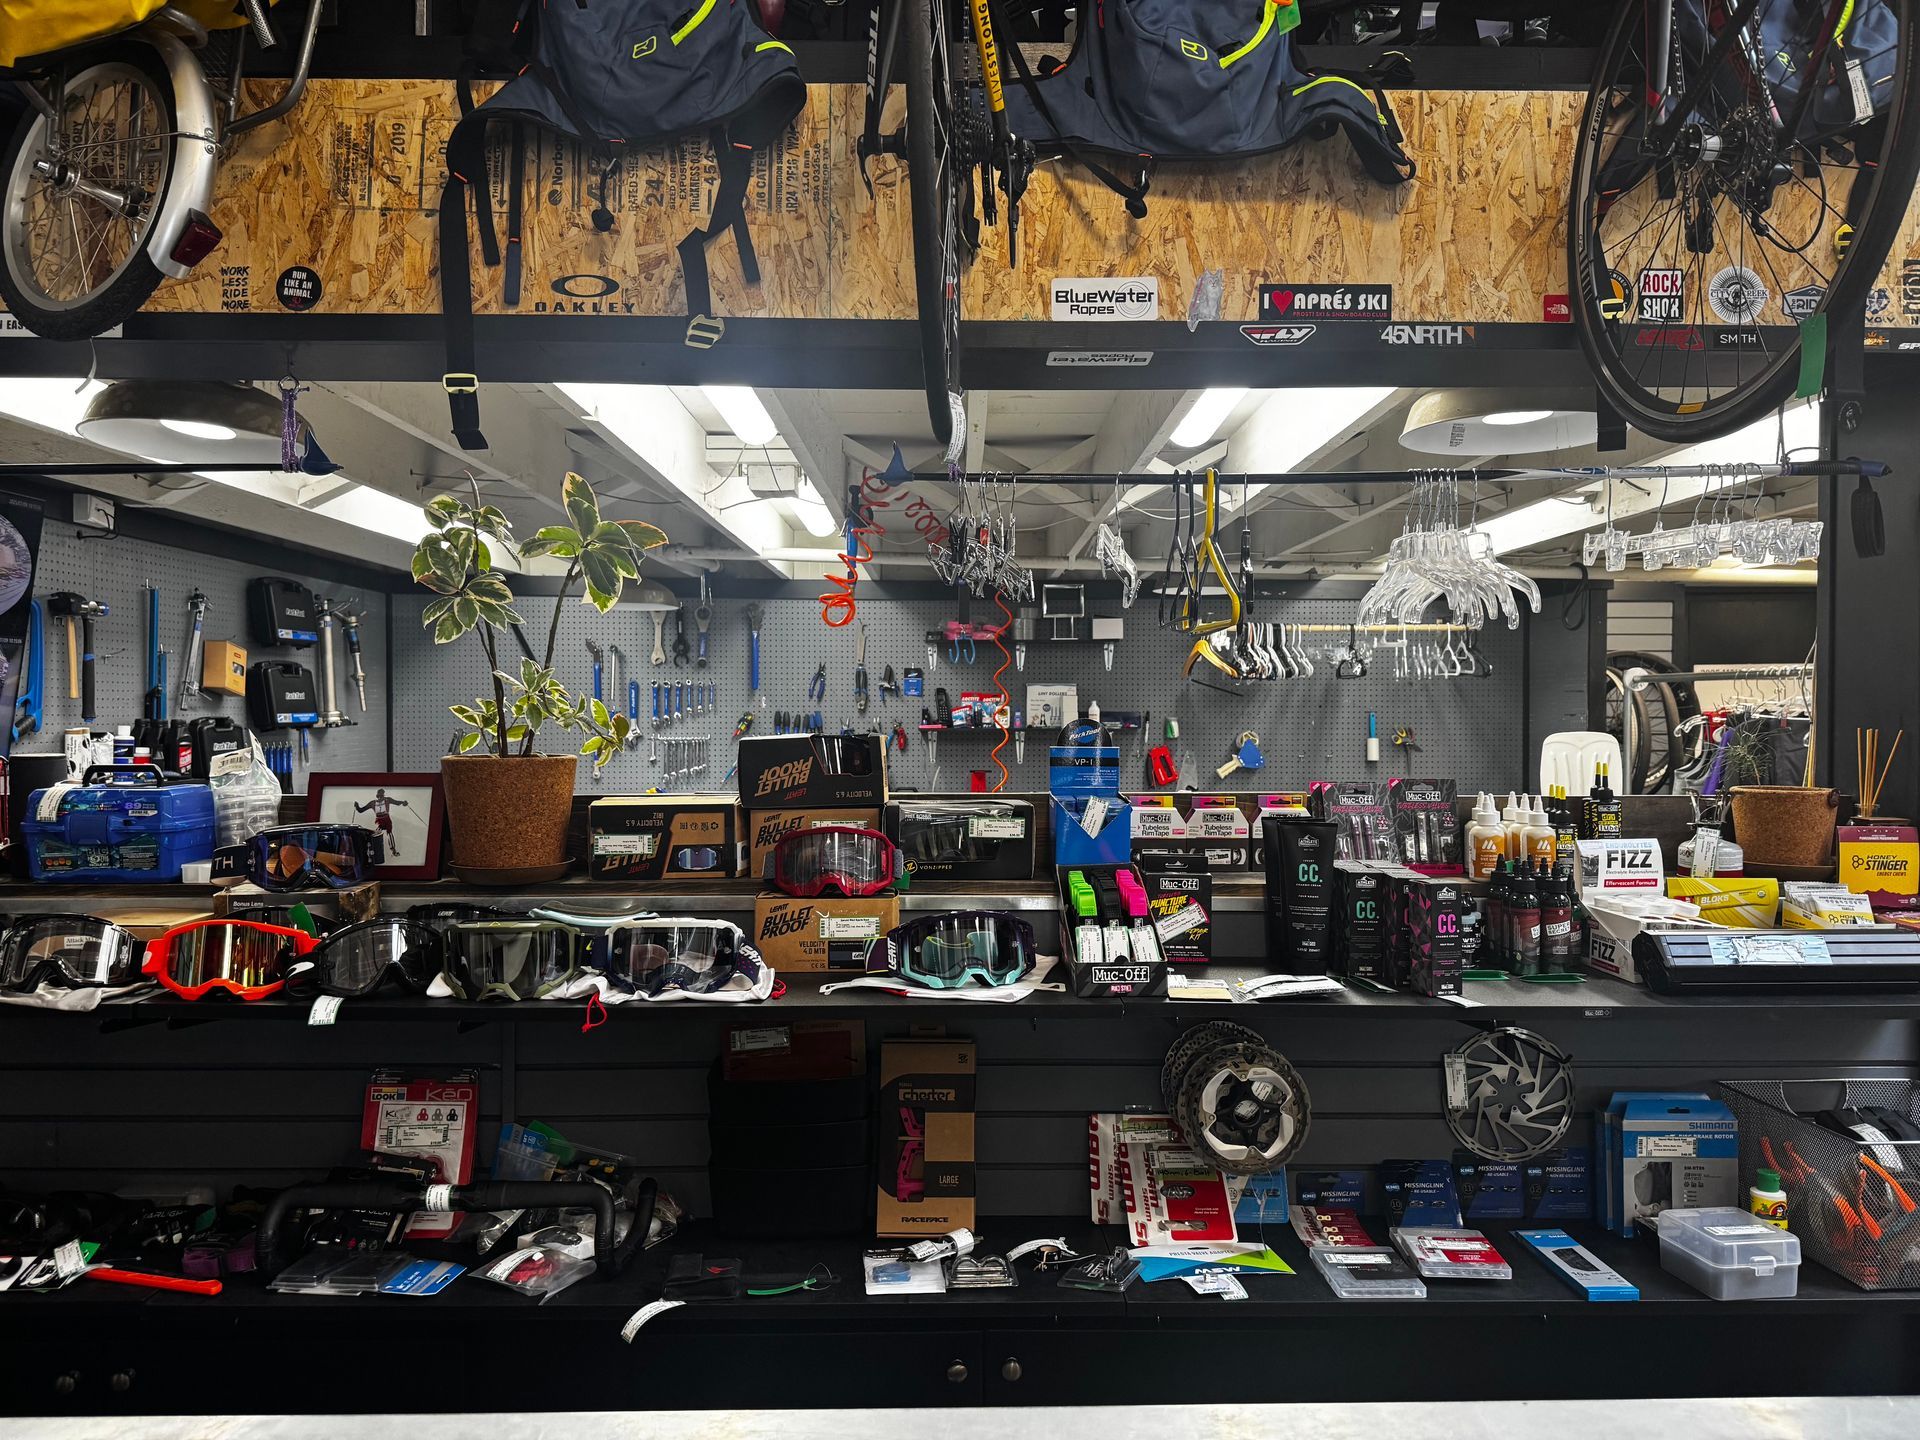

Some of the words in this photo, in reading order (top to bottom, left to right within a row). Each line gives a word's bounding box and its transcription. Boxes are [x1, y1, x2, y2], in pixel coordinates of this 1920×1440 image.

[867, 4, 881, 103] TREK
[978, 3, 1002, 104] LIVESTRONG
[1592, 97, 1605, 126] SWISS
[390, 122, 405, 155] 2019
[1589, 126, 1598, 142] DT
[680, 146, 688, 200] EXPOSURE
[704, 153, 717, 186] 454
[755, 151, 767, 189] CATEG
[220, 266, 250, 276] WORK
[291, 270, 308, 280] RUN
[221, 277, 249, 287] LESS
[284, 279, 301, 288] LIKE
[302, 279, 314, 289] AN
[1643, 273, 1680, 294] ROCK
[222, 288, 249, 298] RIDE
[283, 288, 314, 299] ANIMAL.
[1055, 288, 1154, 303] BlueWater
[1710, 290, 1731, 298] CITY
[221, 300, 250, 310] MORE
[534, 302, 636, 313] OAKLEY
[1263, 293, 1270, 309] I
[1358, 294, 1387, 310] SKI
[1643, 298, 1680, 318] SHOX
[1070, 304, 1115, 316] Ropes
[1381, 326, 1463, 345] 45NRTH
[757, 756, 814, 784] PROOF
[755, 770, 811, 797] BULLET
[845, 790, 873, 798] VELOCITY
[1340, 796, 1374, 805] Muc-Off
[1407, 792, 1440, 800] Muc-Off
[758, 816, 805, 834] BULLET
[1606, 849, 1652, 868] FIZZ
[1864, 860, 1908, 871] STINGER
[1162, 880, 1197, 888] Muc-Off
[1150, 895, 1188, 909] PUNCTURE
[1701, 894, 1729, 905] BLOKS
[762, 905, 814, 927] BULLET
[1159, 905, 1181, 916] PLUG
[759, 919, 809, 940] PROOF
[799, 940, 826, 948] VELOCITY
[888, 937, 898, 970] LEATT
[1591, 941, 1617, 962] FIZZ
[1094, 968, 1147, 981] Muc-Off
[372, 1093, 397, 1101] LOOK
[902, 1089, 950, 1101] chester
[1689, 1122, 1734, 1130] SHIMANO
[939, 1175, 960, 1184] LARGE
[1141, 1187, 1152, 1222] SRAM
[901, 1216, 949, 1224] RACEFACE
